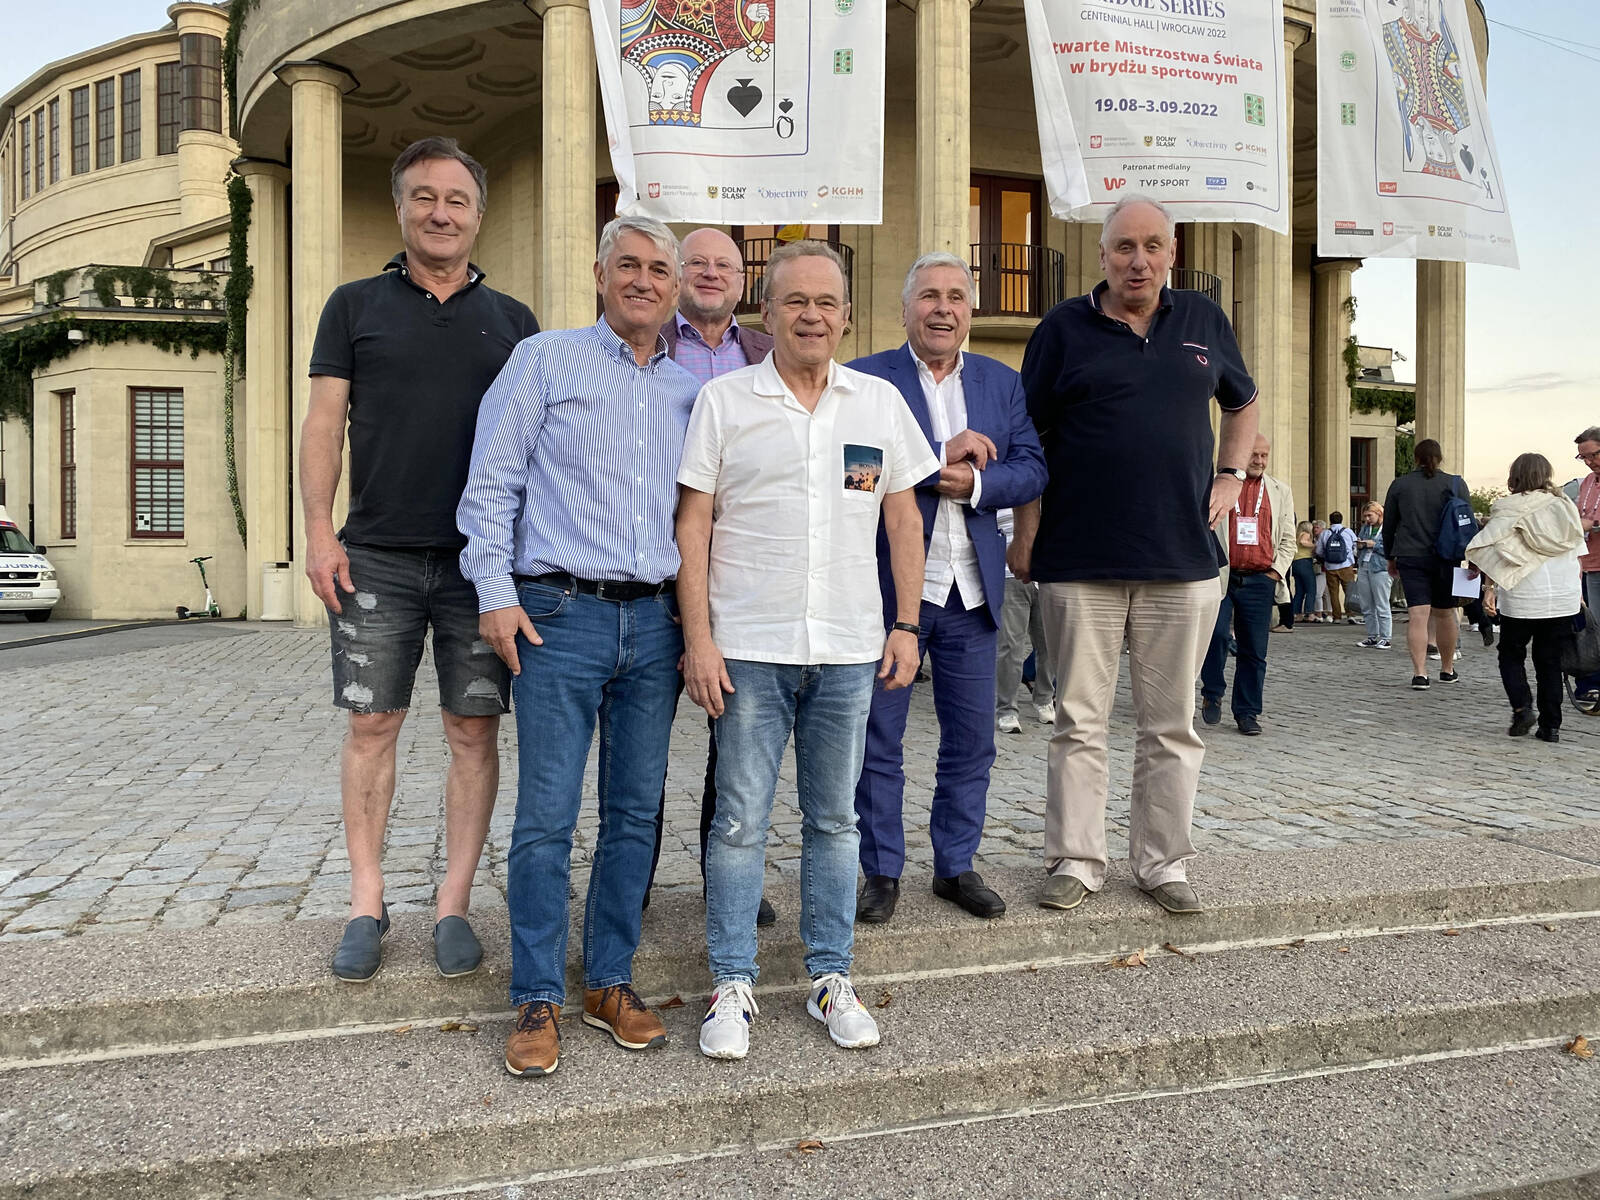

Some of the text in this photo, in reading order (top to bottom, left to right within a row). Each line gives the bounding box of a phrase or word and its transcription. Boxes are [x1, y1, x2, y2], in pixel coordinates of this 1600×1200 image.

[1160, 0, 1226, 18] SERIES
[1080, 10, 1132, 26] CENTENNIAL
[1134, 19, 1154, 30] HALL
[1162, 22, 1205, 36] WROCŁAW
[1207, 28, 1226, 38] 2022
[1053, 39, 1263, 72] twarte Mistrzostwa Świata
[1070, 59, 1238, 86] w brydżu sportowym
[1122, 163, 1191, 172] Patronat medialny
[1103, 177, 1126, 191] WP
[1140, 179, 1190, 187] TVP SPORT
[761, 189, 808, 199] Objectivity
[832, 187, 864, 195] KGHM
